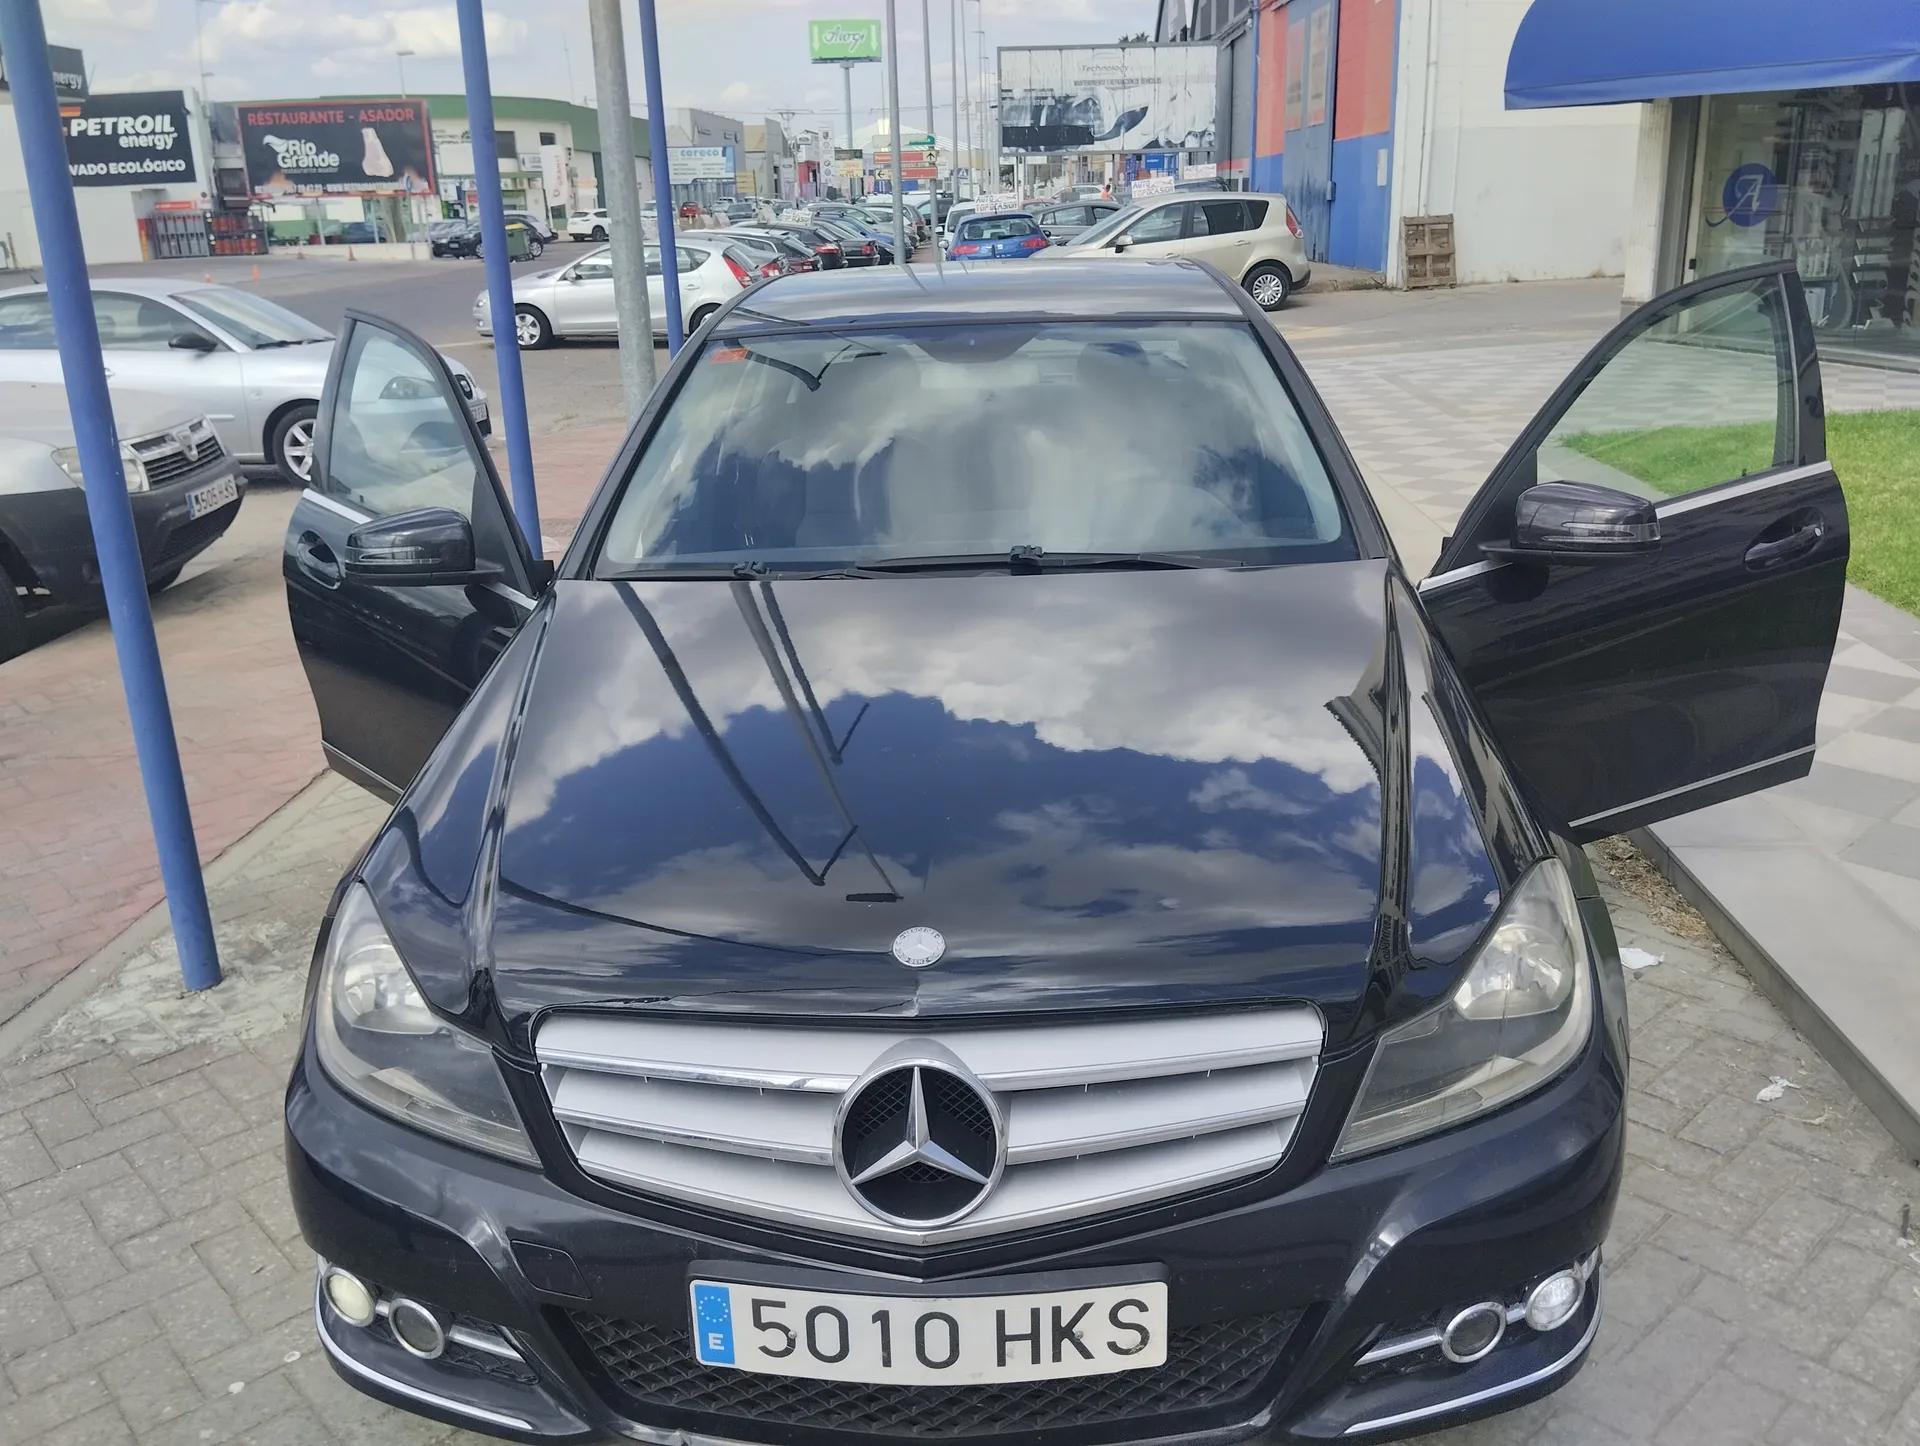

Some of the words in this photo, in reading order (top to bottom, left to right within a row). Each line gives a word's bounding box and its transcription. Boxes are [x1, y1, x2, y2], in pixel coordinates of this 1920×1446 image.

[53, 71, 83, 90] nergy
[70, 114, 175, 137] PETROIL
[248, 110, 345, 126] RESTAURANTE
[359, 108, 415, 123] ASADOR
[119, 133, 173, 150] energy
[288, 139, 317, 155] Río
[109, 157, 186, 175] ECOLÓGICO
[277, 150, 340, 169] Grande
[708, 1332, 725, 1351] E
[751, 1298, 960, 1370] 5010
[995, 1298, 1151, 1367] HKS
